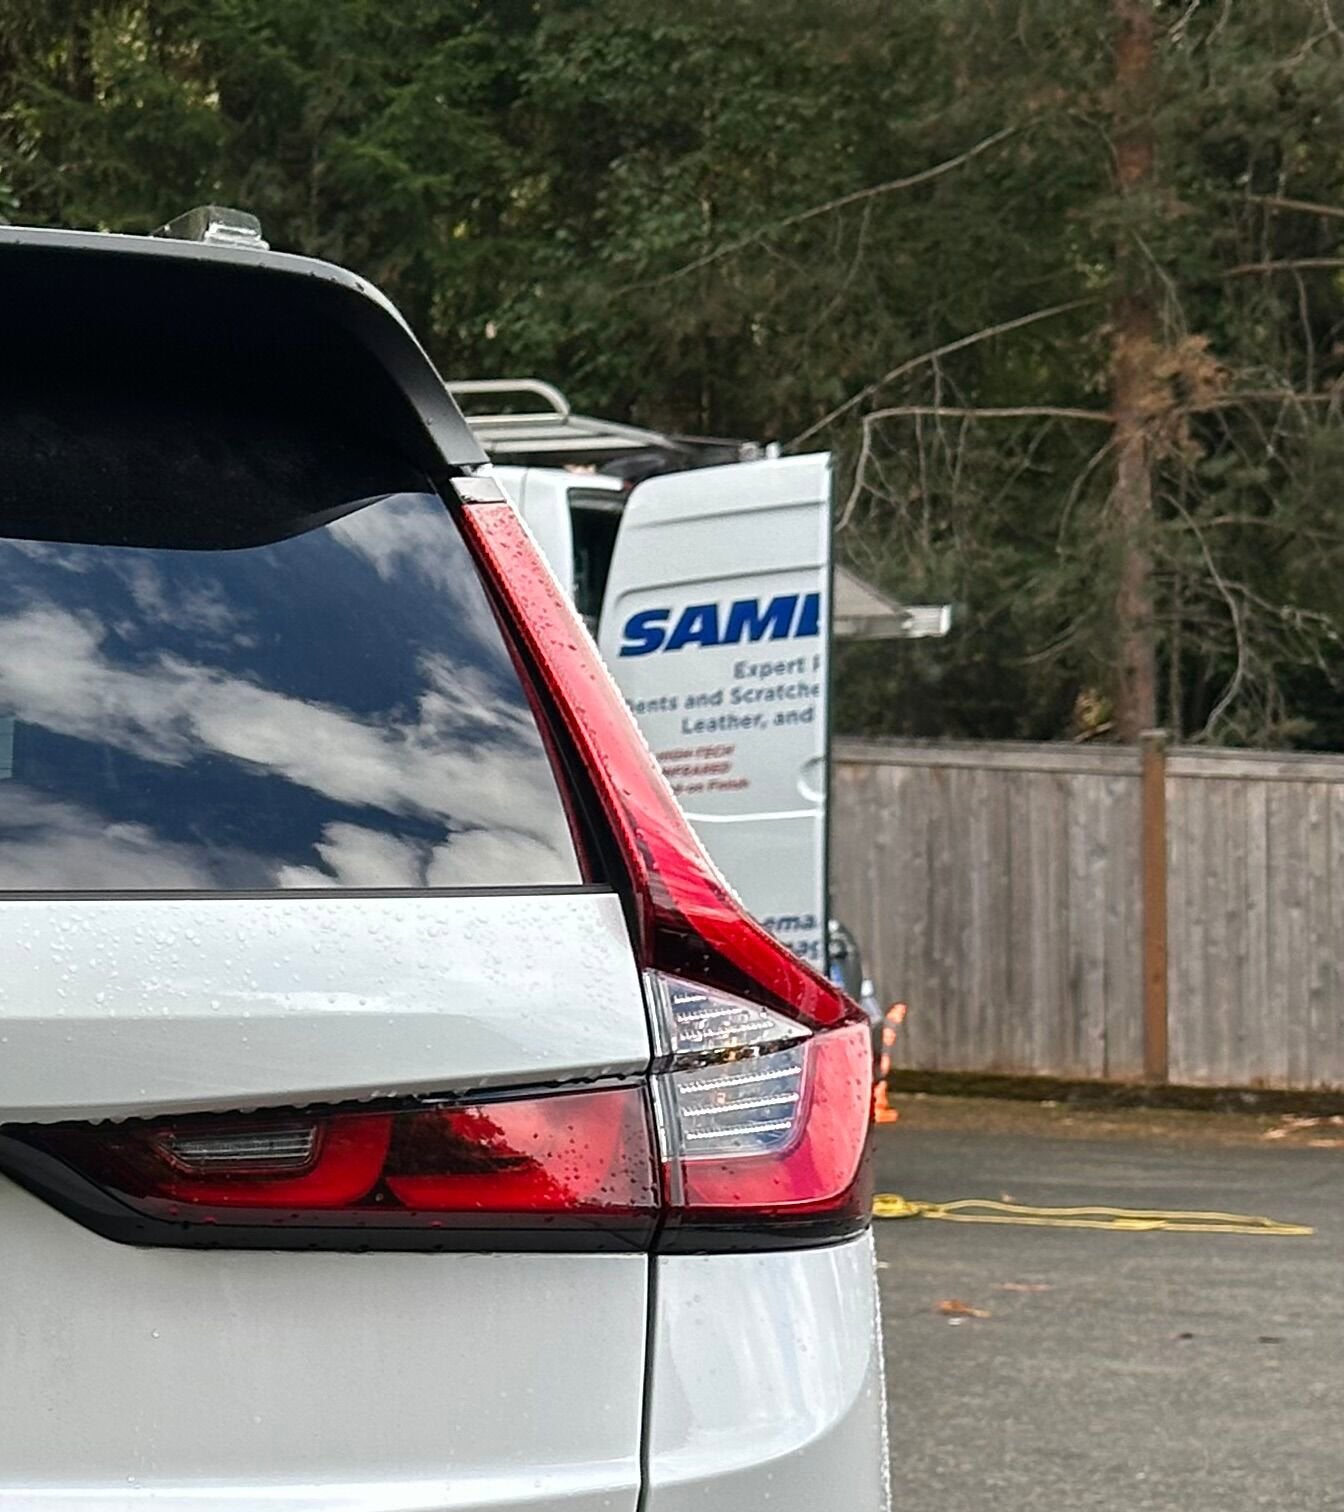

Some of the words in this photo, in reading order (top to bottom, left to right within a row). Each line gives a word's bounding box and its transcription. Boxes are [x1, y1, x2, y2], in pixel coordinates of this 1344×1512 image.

[734, 656, 805, 679] Expert
[625, 696, 677, 713] ents
[684, 690, 723, 709] and
[681, 714, 767, 734] Leather,
[773, 707, 814, 725] and
